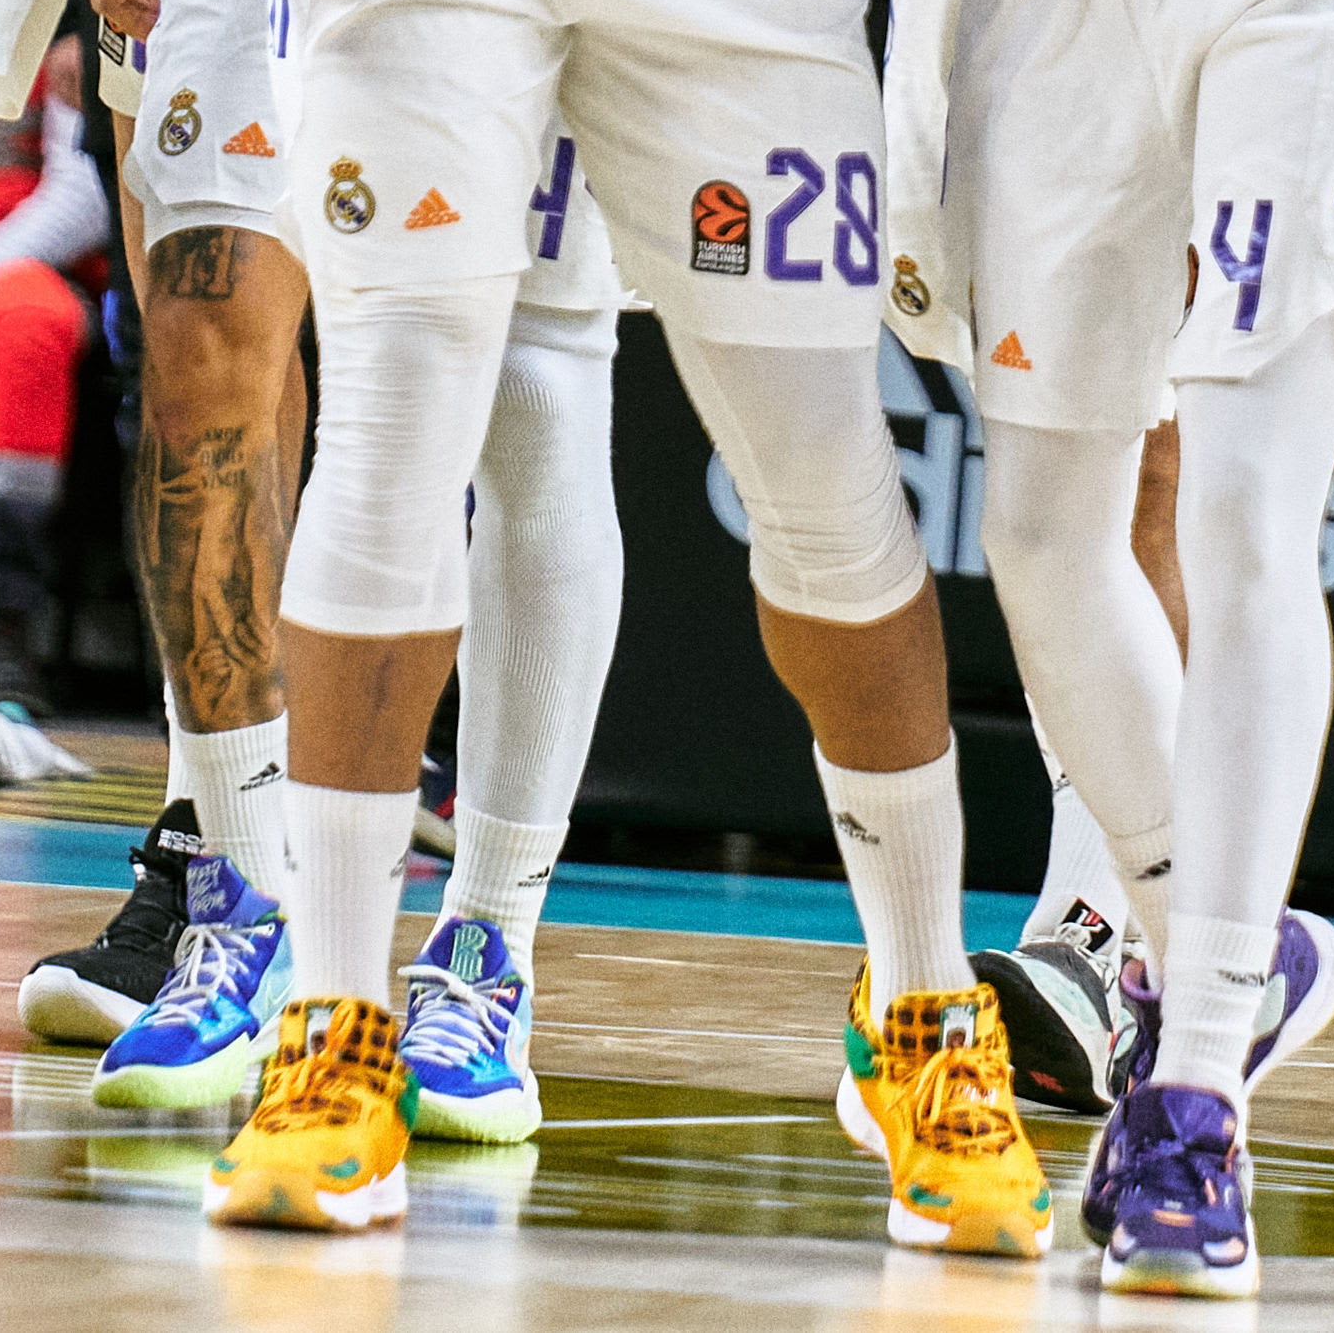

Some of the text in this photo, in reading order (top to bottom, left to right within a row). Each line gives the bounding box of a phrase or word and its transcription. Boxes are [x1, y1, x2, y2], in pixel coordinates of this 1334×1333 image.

[698, 240, 746, 254] TURKISH
[764, 147, 880, 286] 28
[1209, 199, 1273, 331] 4
